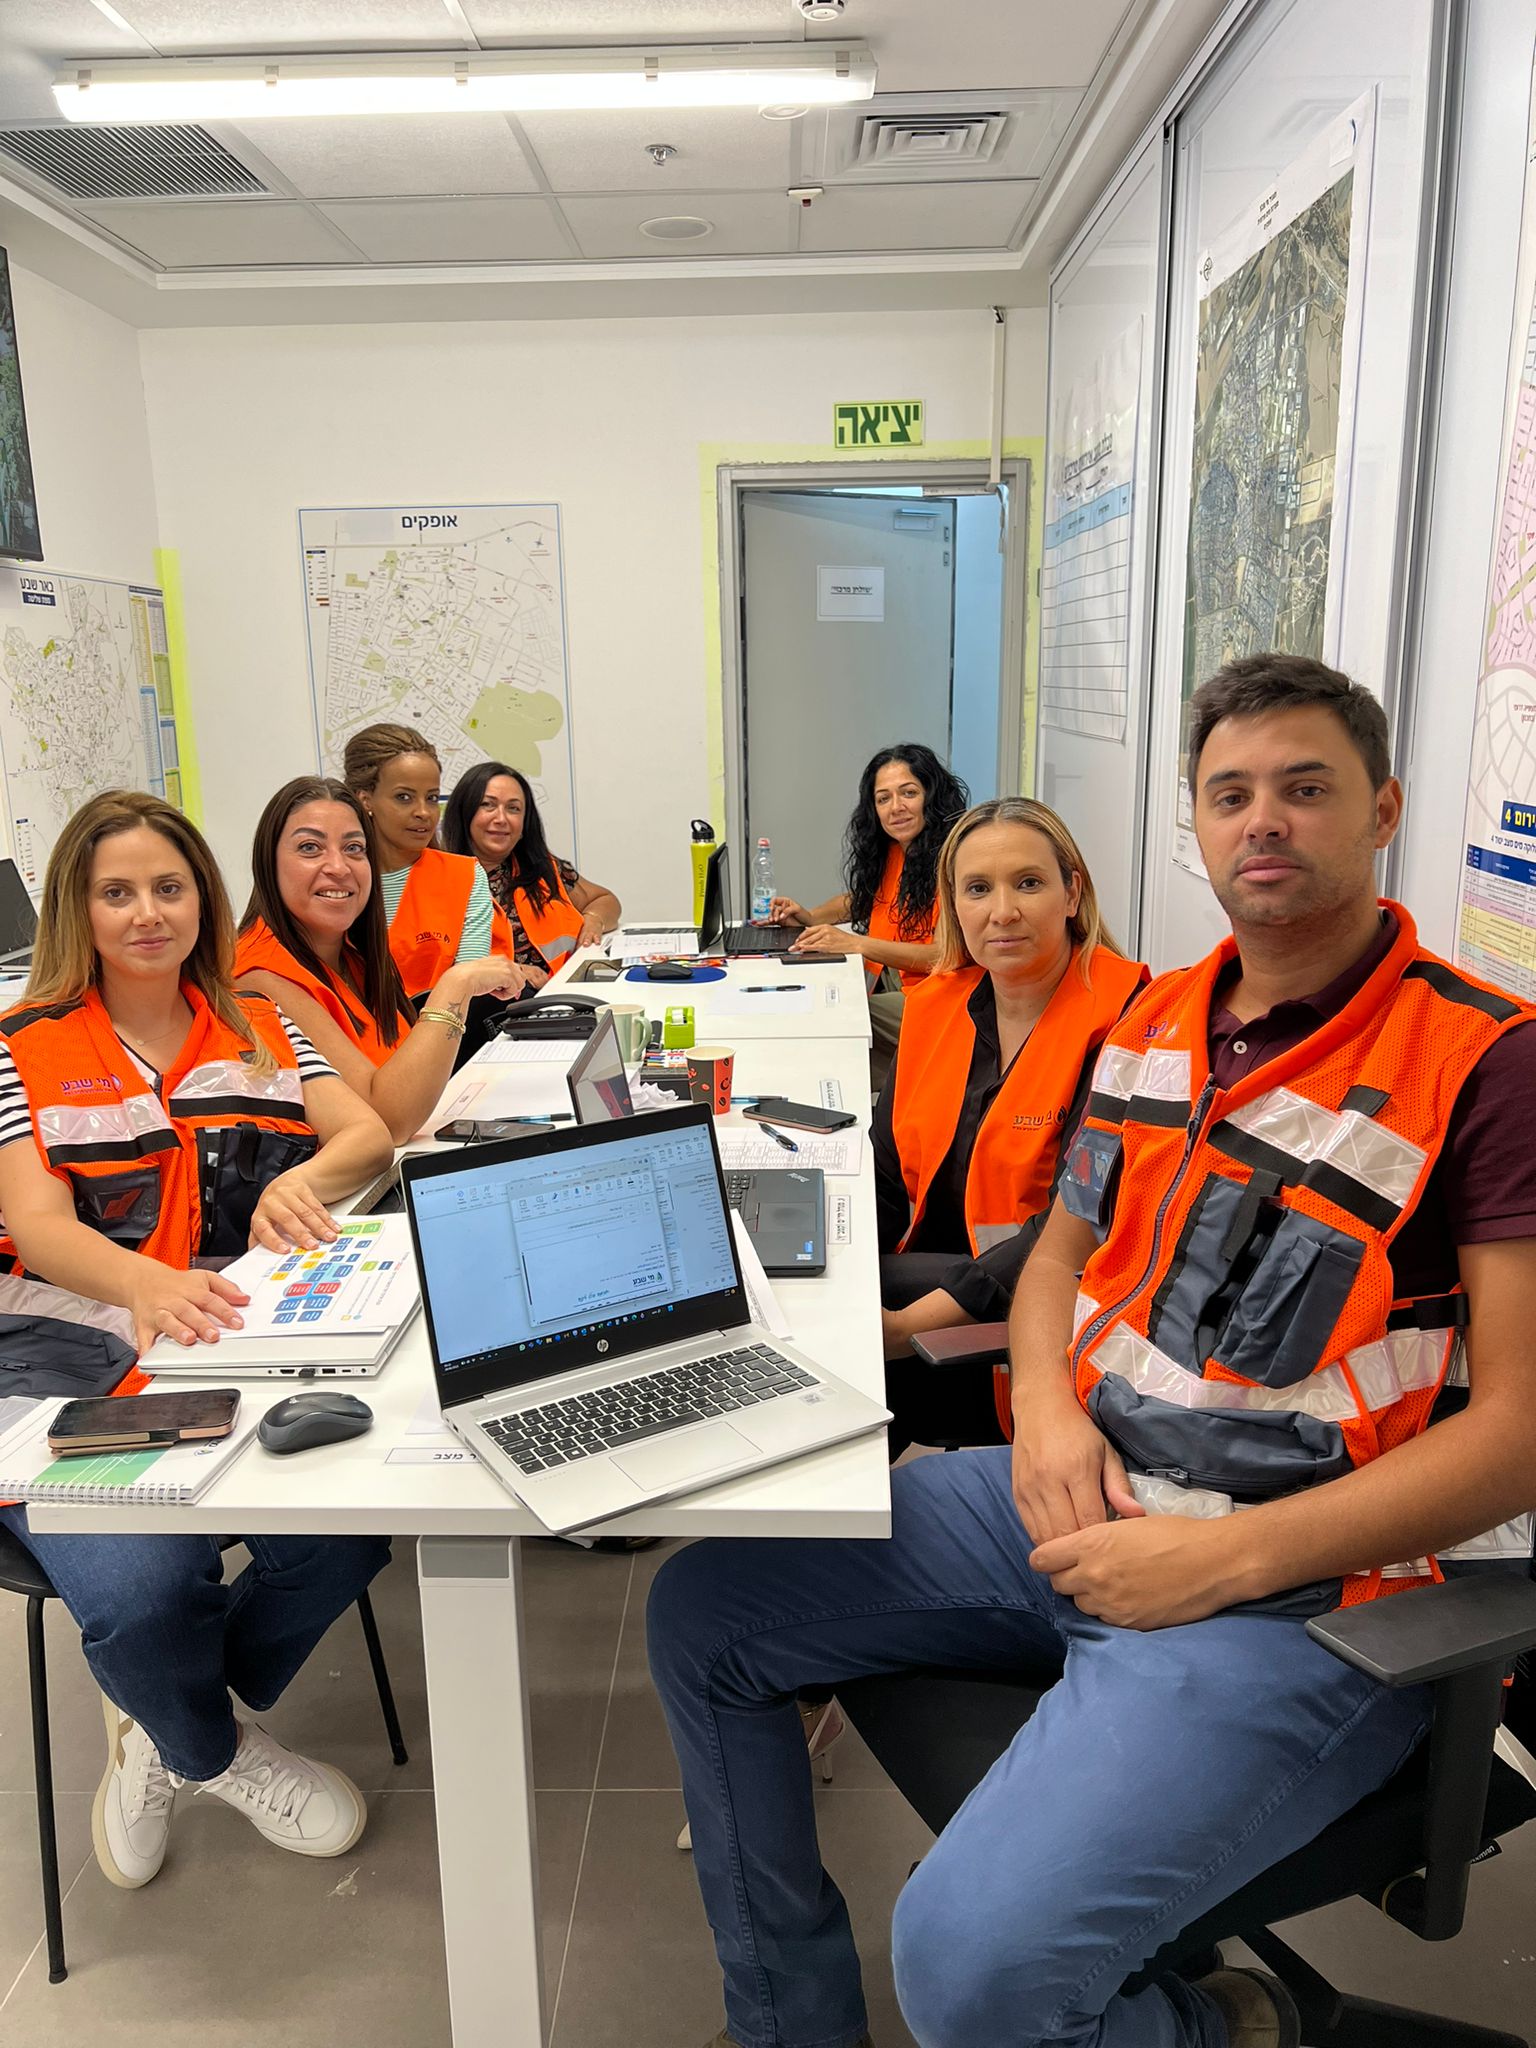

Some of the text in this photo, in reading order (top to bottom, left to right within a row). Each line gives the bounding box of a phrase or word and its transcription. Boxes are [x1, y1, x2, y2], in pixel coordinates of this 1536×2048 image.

[838, 405, 919, 444] יציאה
[401, 514, 458, 530] אופקים
[20, 577, 54, 592] באר שבע
[1505, 808, 1536, 828] ירום 4
[60, 1077, 111, 1092] מי שבע
